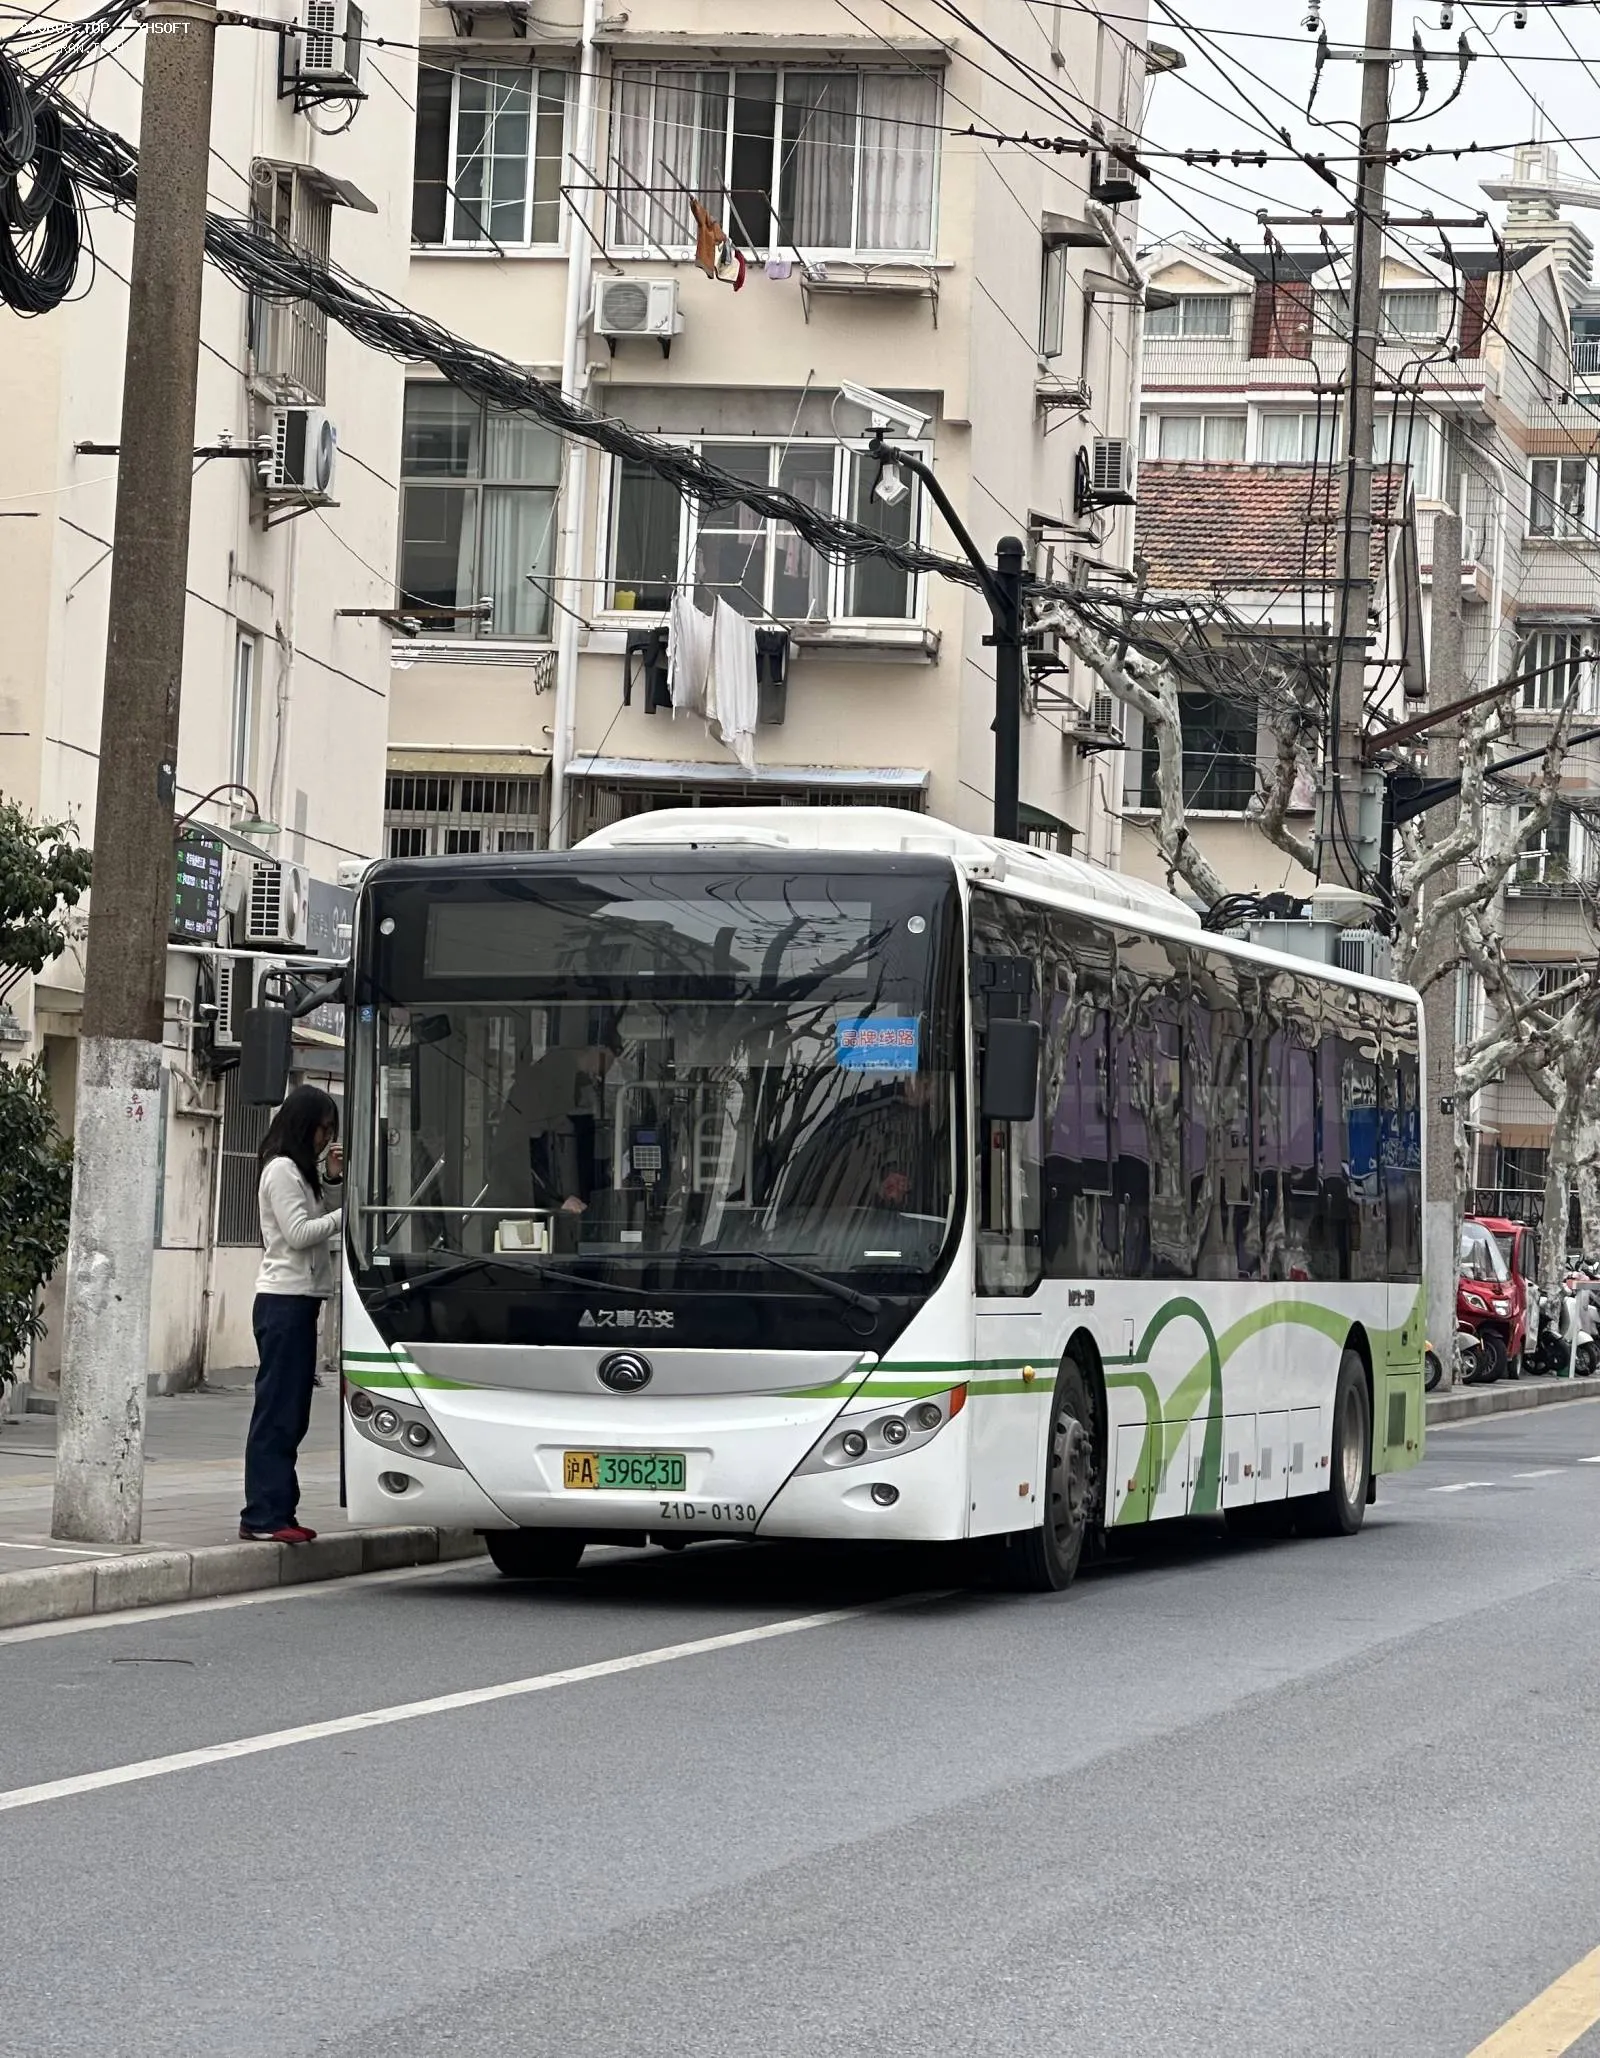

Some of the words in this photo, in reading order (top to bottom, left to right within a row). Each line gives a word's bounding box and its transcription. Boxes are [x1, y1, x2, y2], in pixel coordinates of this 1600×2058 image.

[841, 1028, 914, 1048] 品牌线路
[660, 1501, 756, 1522] Z1D-0130
